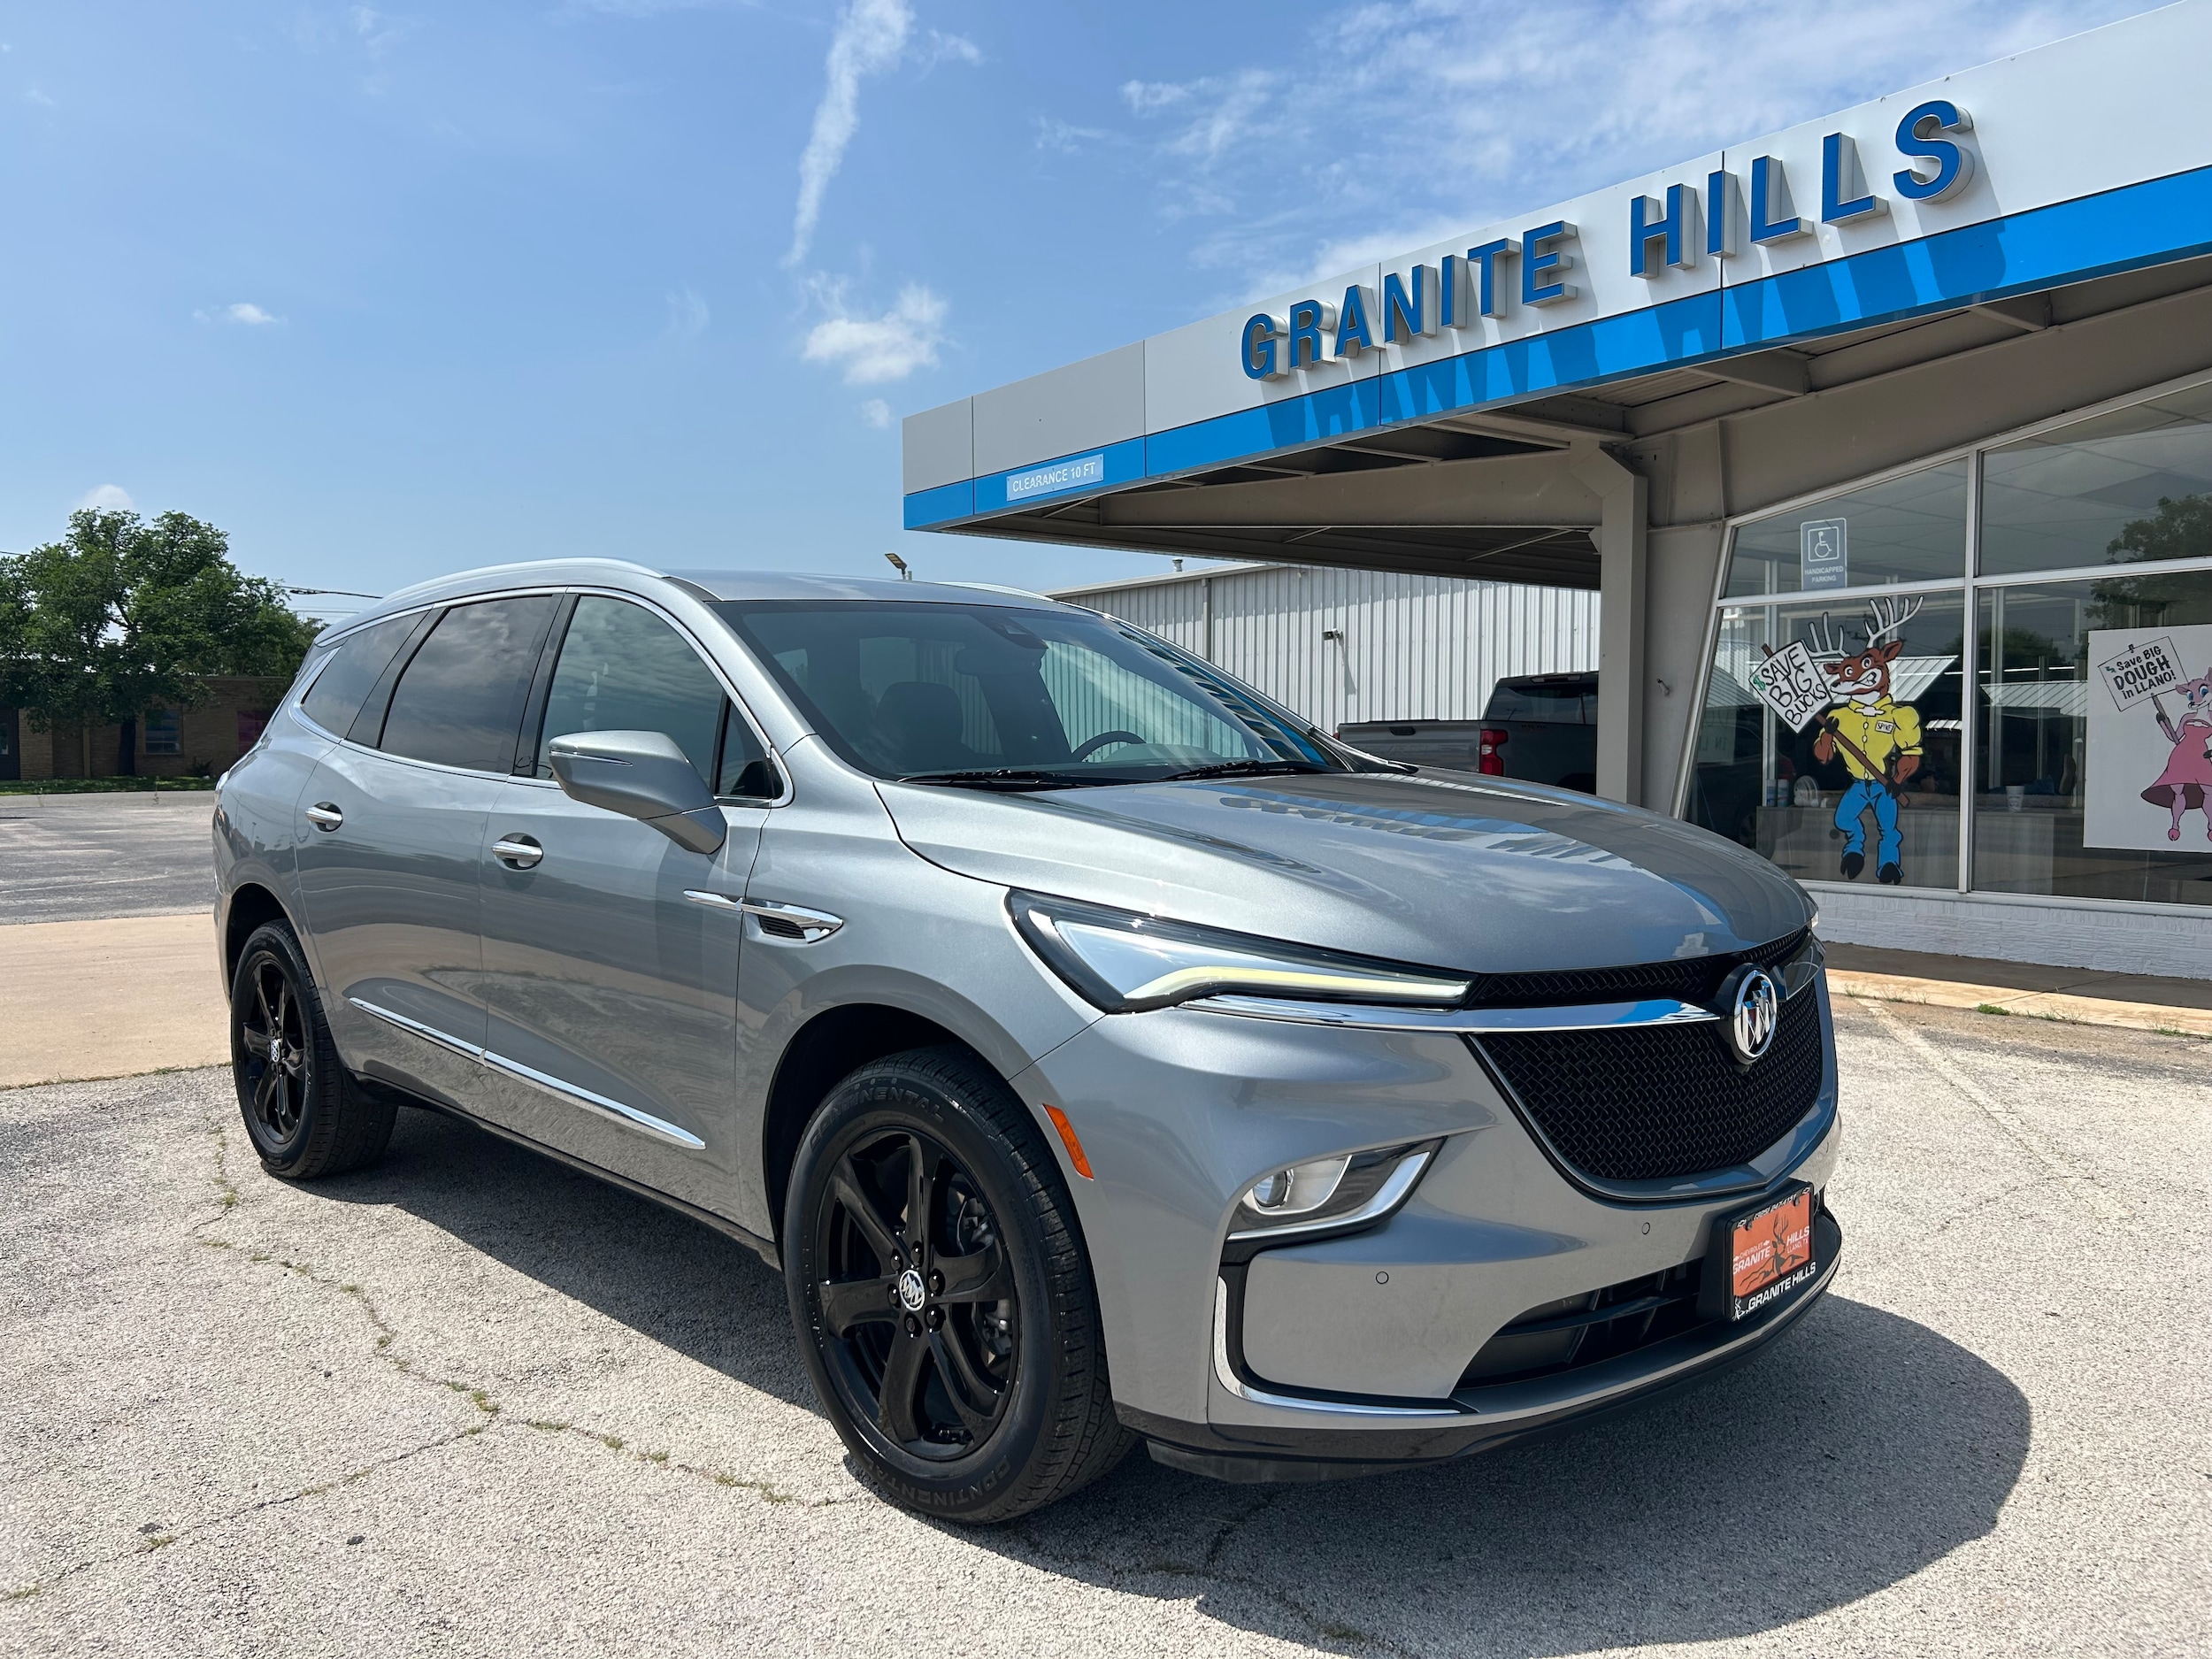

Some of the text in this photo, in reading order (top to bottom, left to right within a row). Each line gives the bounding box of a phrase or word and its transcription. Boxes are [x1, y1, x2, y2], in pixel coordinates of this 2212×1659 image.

[1241, 100, 1975, 381] GRANITE HILLS
[1012, 462, 1096, 493] CLEARANCE 10 FT
[1804, 565, 1844, 575] HANDICAPPED
[1811, 574, 1837, 583] PARKING
[2143, 645, 2162, 660] BIG
[1769, 668, 1812, 708] BIG
[2113, 654, 2171, 691] DOUGH
[2121, 669, 2177, 700] in LLANO!
[1785, 683, 1827, 726] BUCKS
[809, 1086, 945, 1152] CONTINENTAL
[1732, 1225, 1810, 1274] GRANITE HILLS
[1740, 1241, 1763, 1259] CHEVROLET
[1747, 1261, 1816, 1310] GRANITE HILLS
[862, 1452, 1012, 1507] CONTINENTAL
